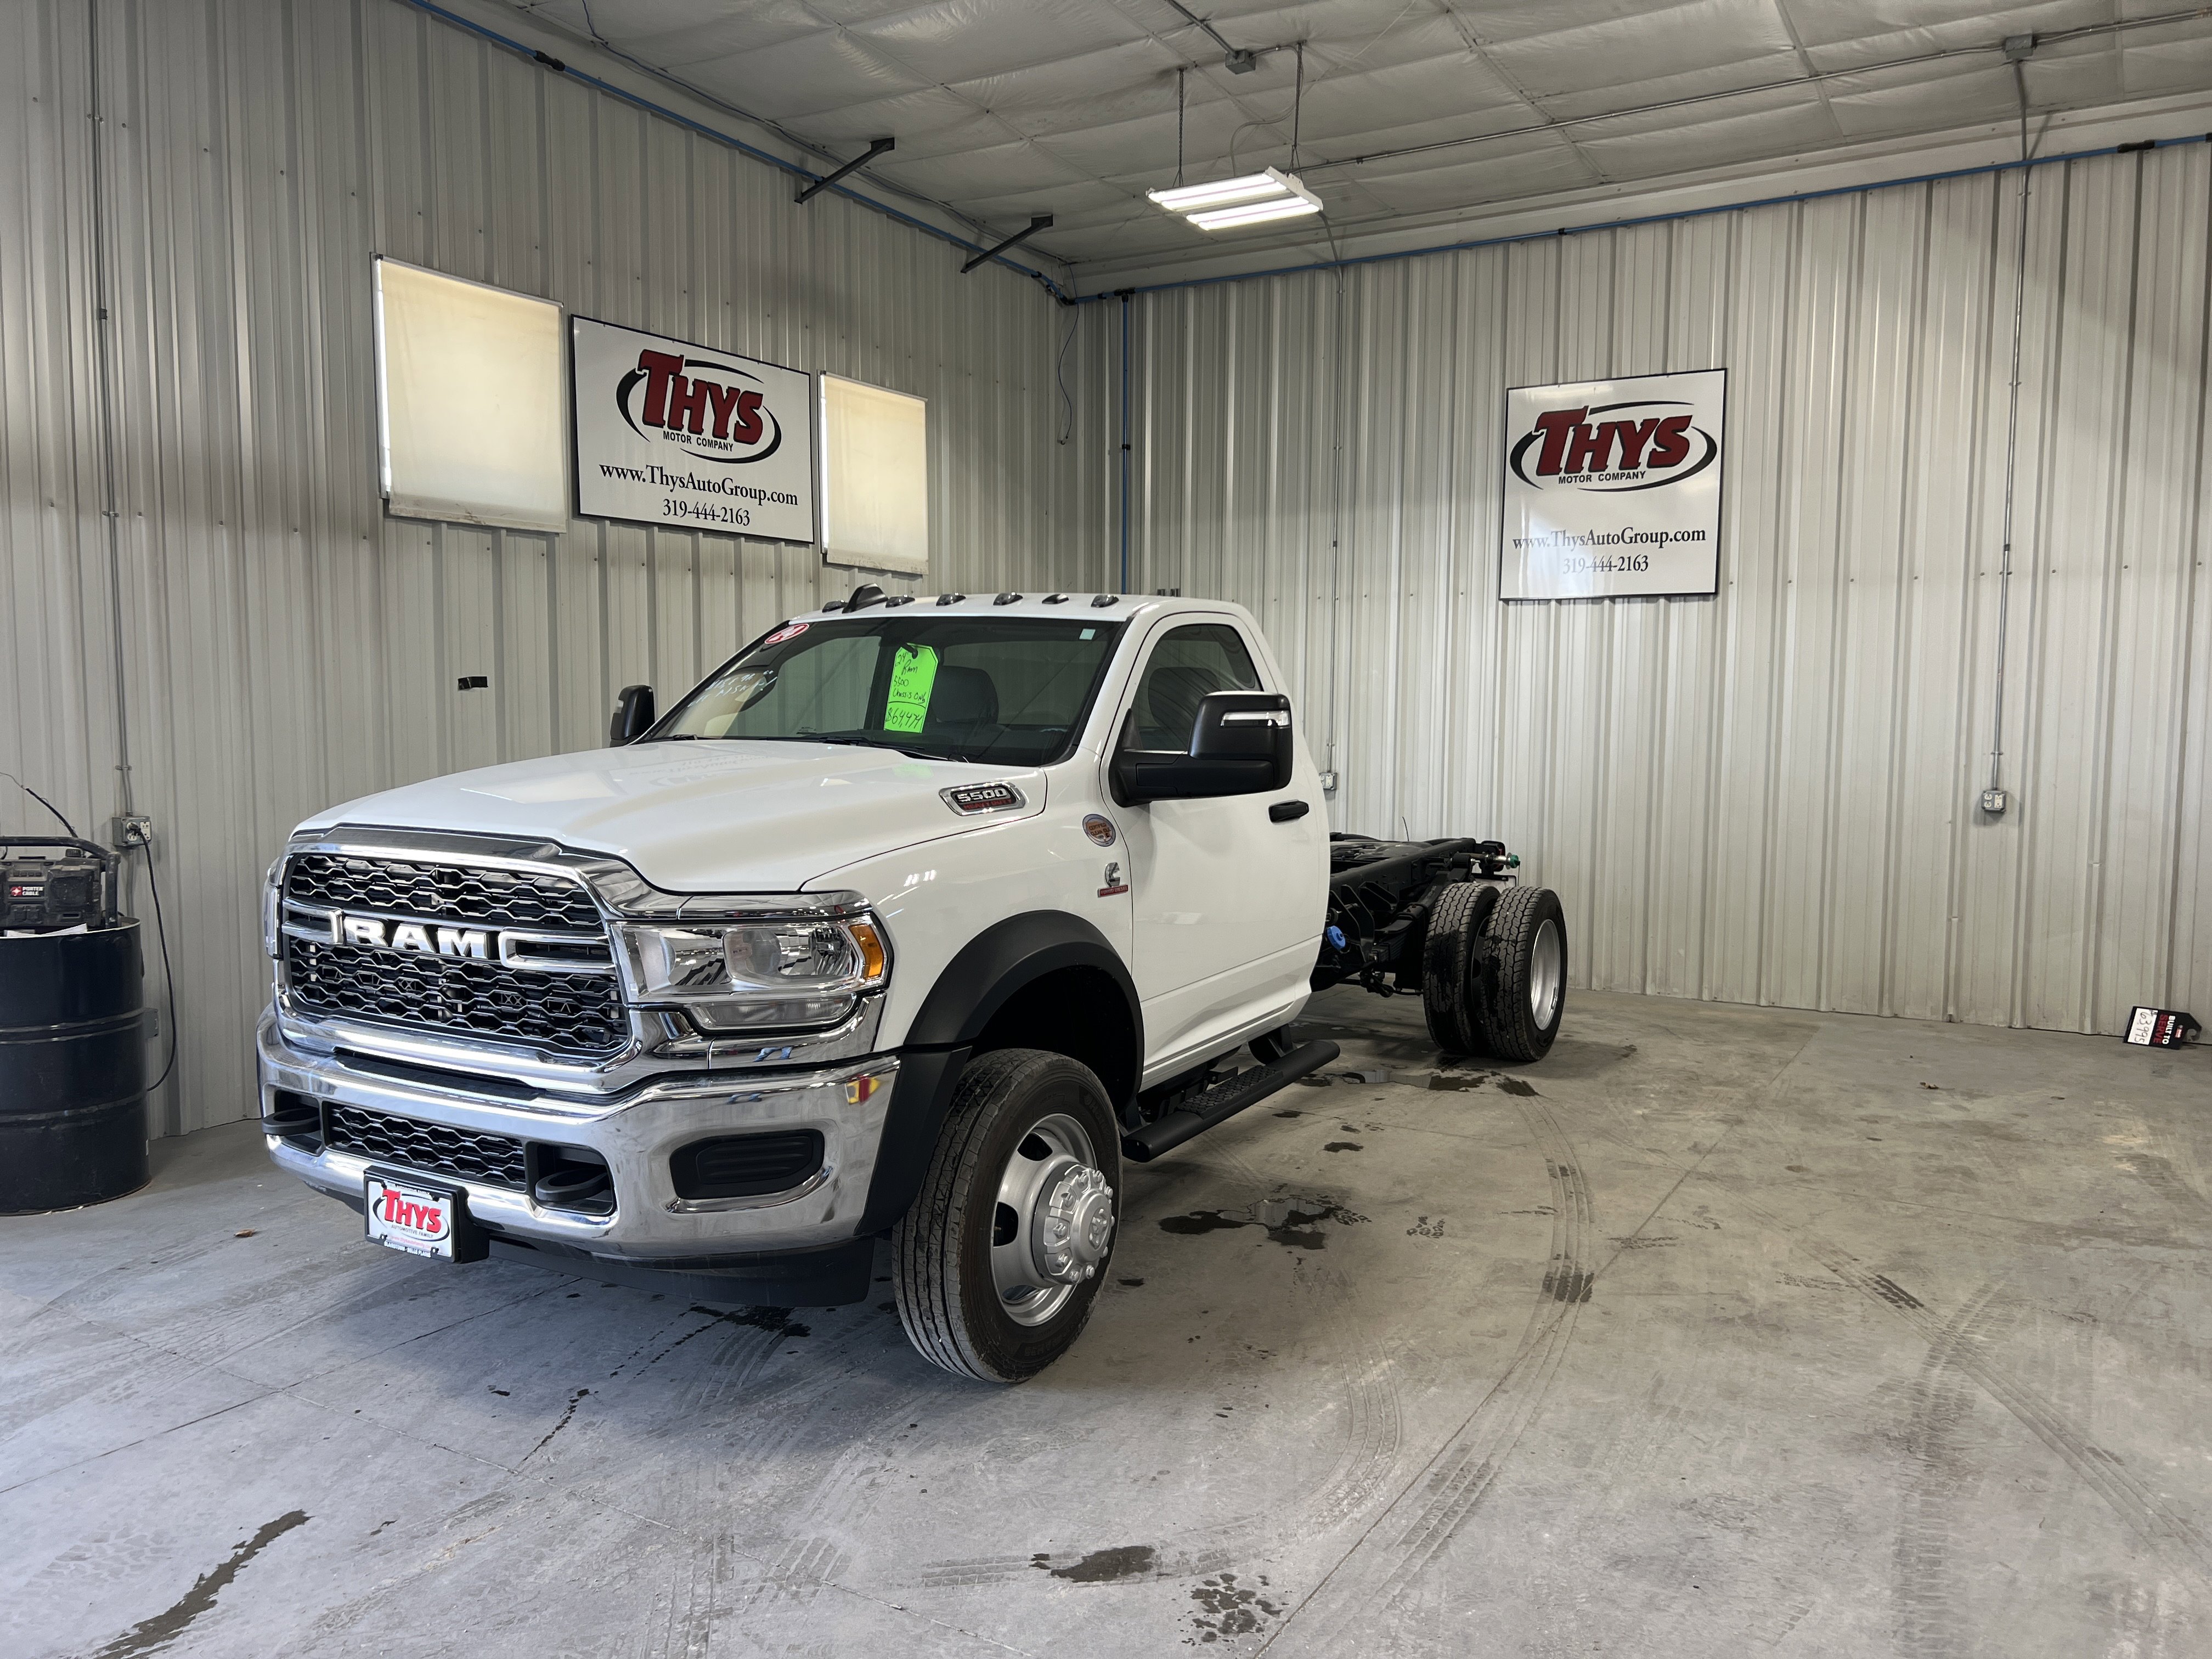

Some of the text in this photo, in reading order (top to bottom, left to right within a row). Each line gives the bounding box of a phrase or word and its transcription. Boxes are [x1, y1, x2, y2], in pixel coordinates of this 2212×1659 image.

[637, 349, 763, 445] THYS
[663, 430, 733, 452] MOTOR COMPANY
[1533, 405, 1693, 477] THYS
[599, 464, 798, 506] www.ThysAutoGroup.com
[1558, 471, 1646, 484] MOTOR COMPANY
[663, 499, 751, 526] 319-444-2163
[1512, 527, 1706, 551] www.ThysAutoGroup.com
[1562, 554, 1649, 574] 319-444-2163
[893, 675, 909, 687] 5500
[957, 788, 1008, 803] 5500
[963, 802, 990, 810] HEAVY
[344, 916, 490, 960] RAM
[2153, 1014, 2169, 1045] SERVE
[2162, 1015, 2176, 1045] BUILT TO
[382, 1188, 442, 1233] THYS
[391, 1224, 434, 1239] AUTOMOTIVE FAMILY
